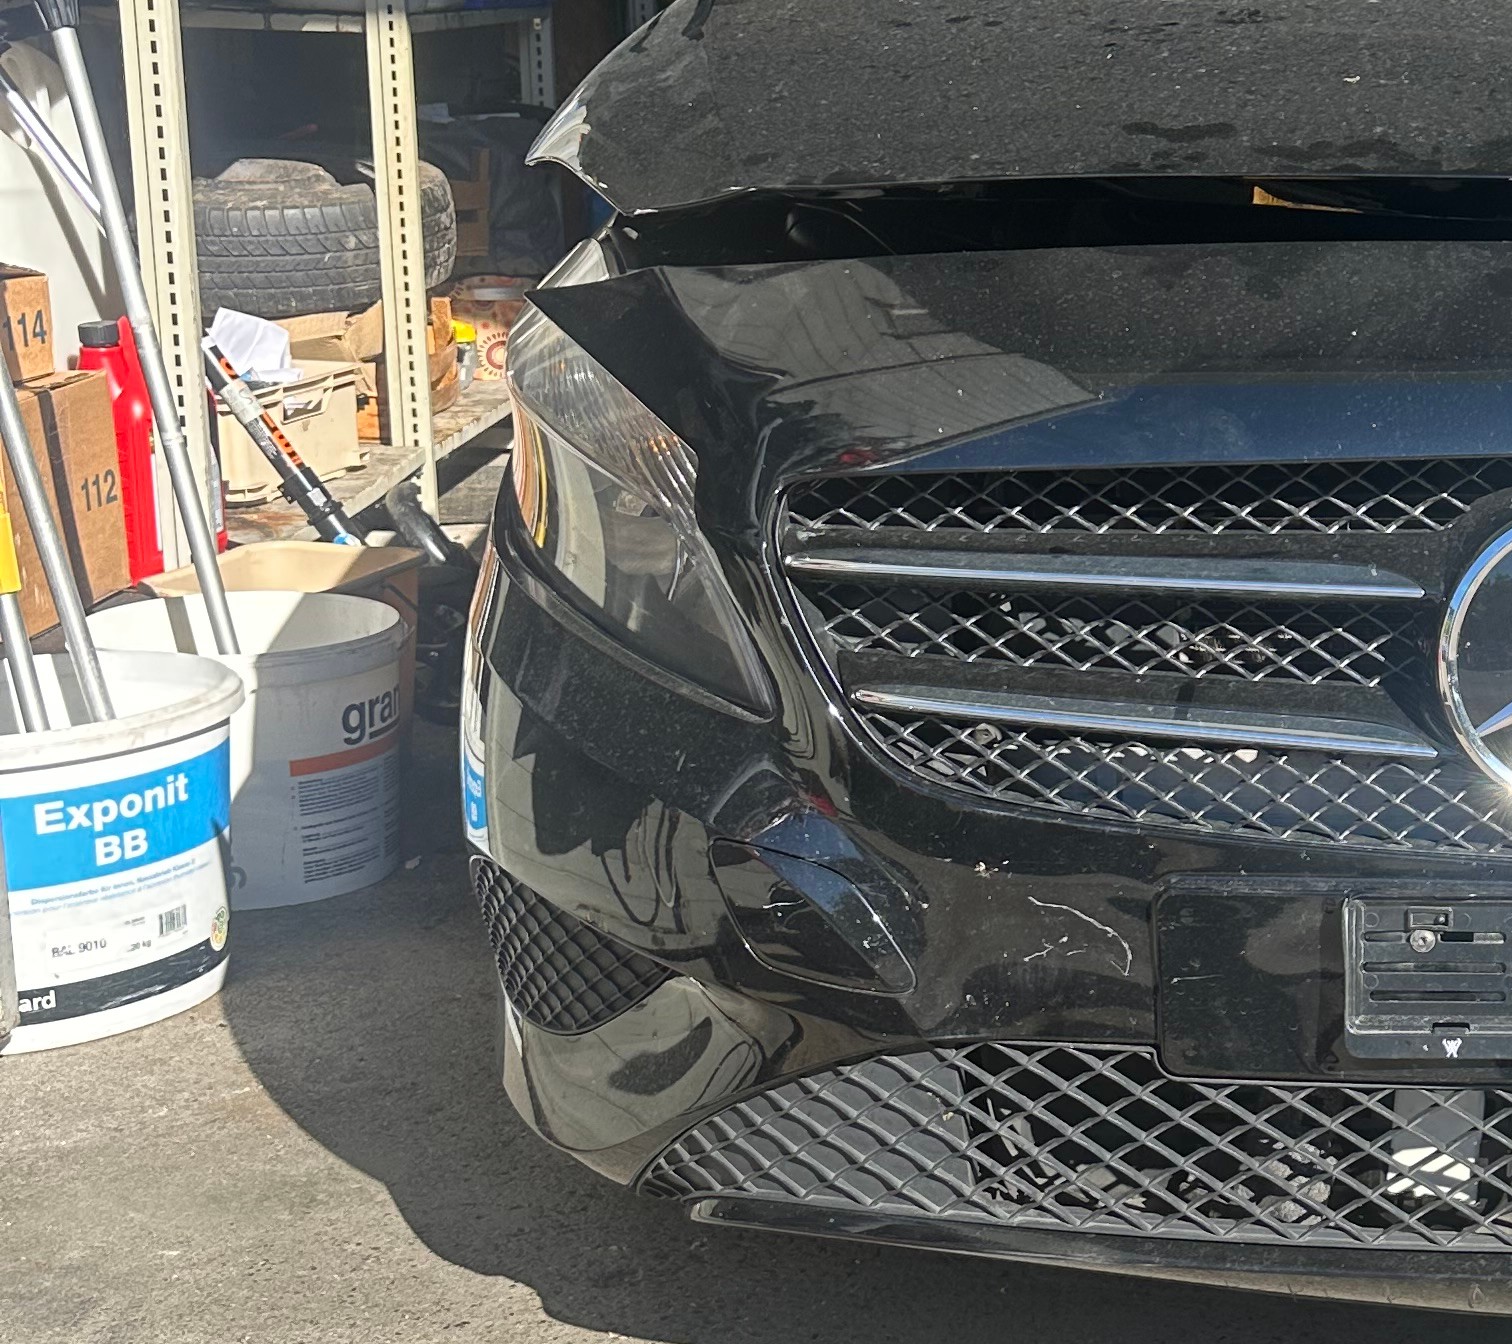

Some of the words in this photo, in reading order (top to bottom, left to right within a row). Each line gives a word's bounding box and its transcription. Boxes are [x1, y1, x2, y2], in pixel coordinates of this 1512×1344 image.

[81, 469, 118, 512] 112
[34, 772, 189, 836] Exponit
[95, 828, 149, 867] BB
[78, 938, 108, 954] 9010
